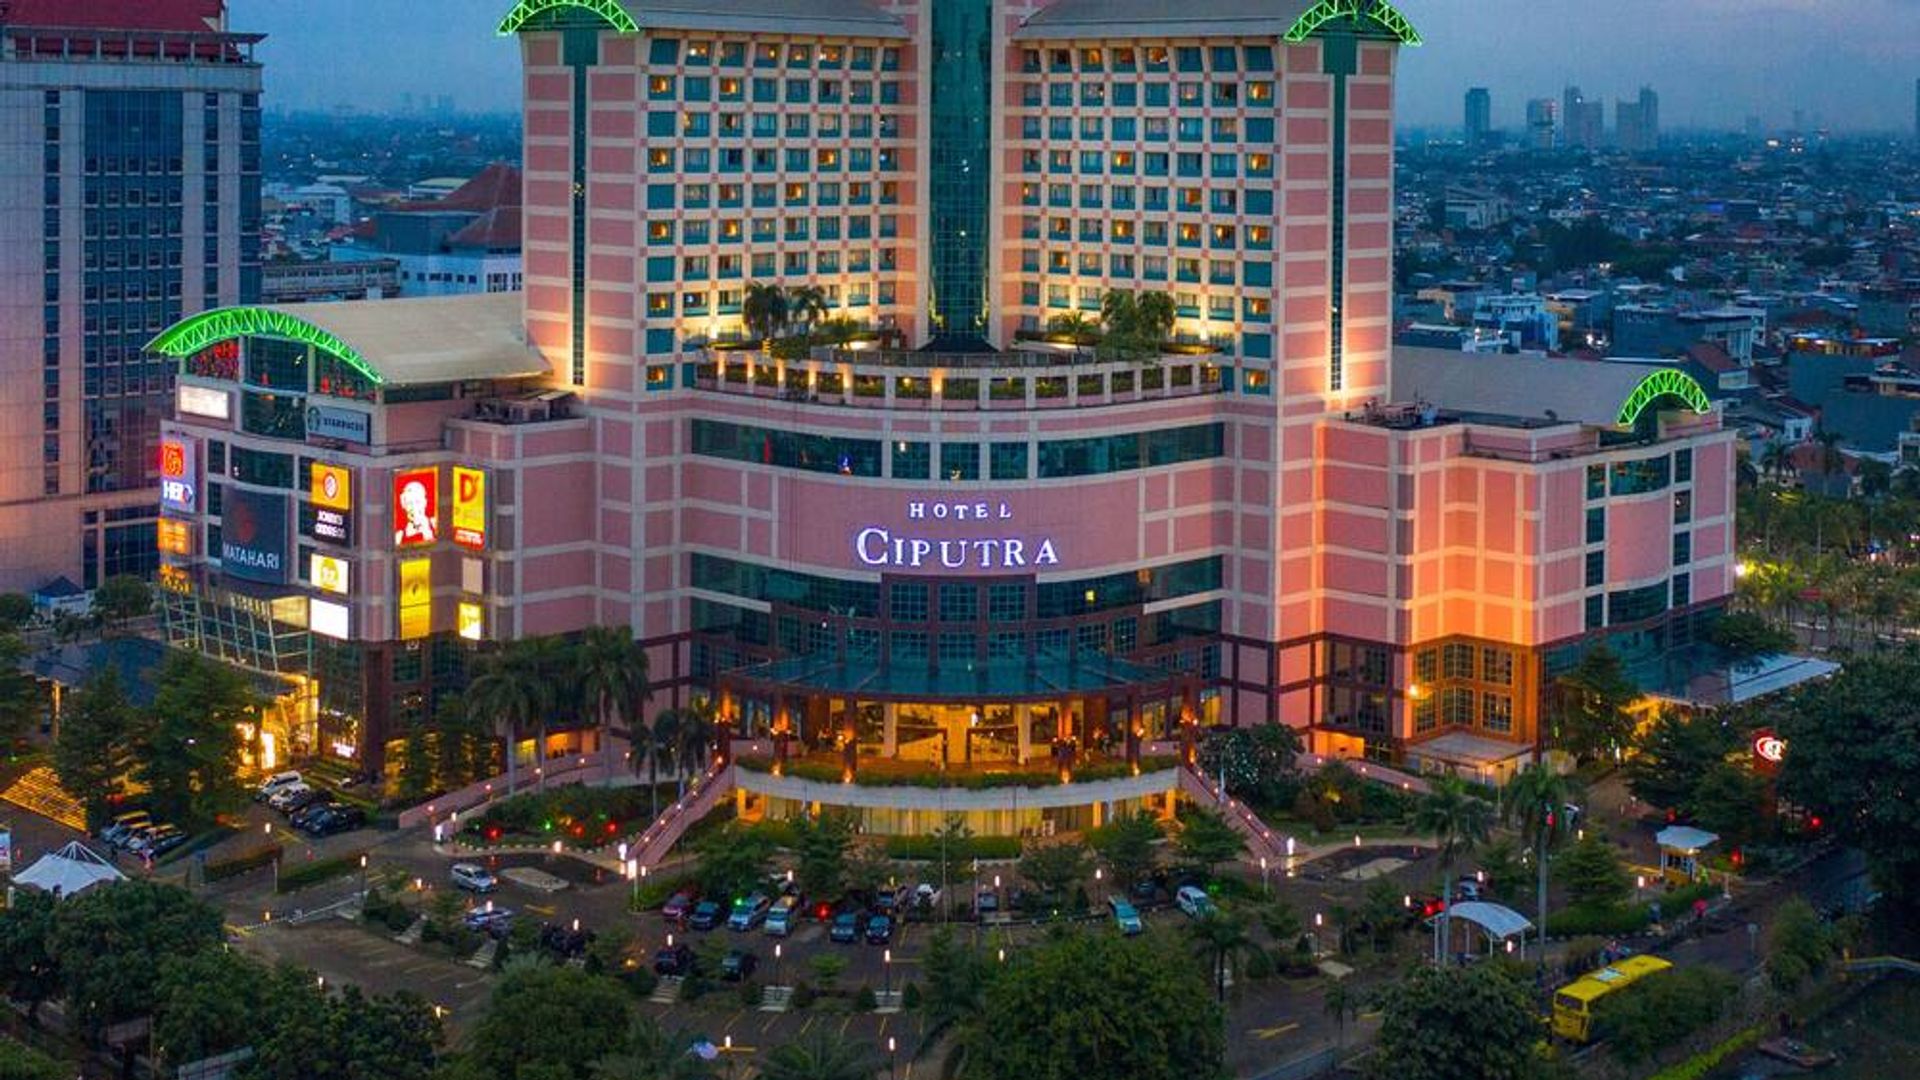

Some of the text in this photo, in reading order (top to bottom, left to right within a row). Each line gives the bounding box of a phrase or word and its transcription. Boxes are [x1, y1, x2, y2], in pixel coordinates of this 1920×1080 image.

[910, 502, 1012, 520] HOTEL
[222, 541, 280, 570] MATAHARI
[856, 527, 1059, 568] CIPUTRA
